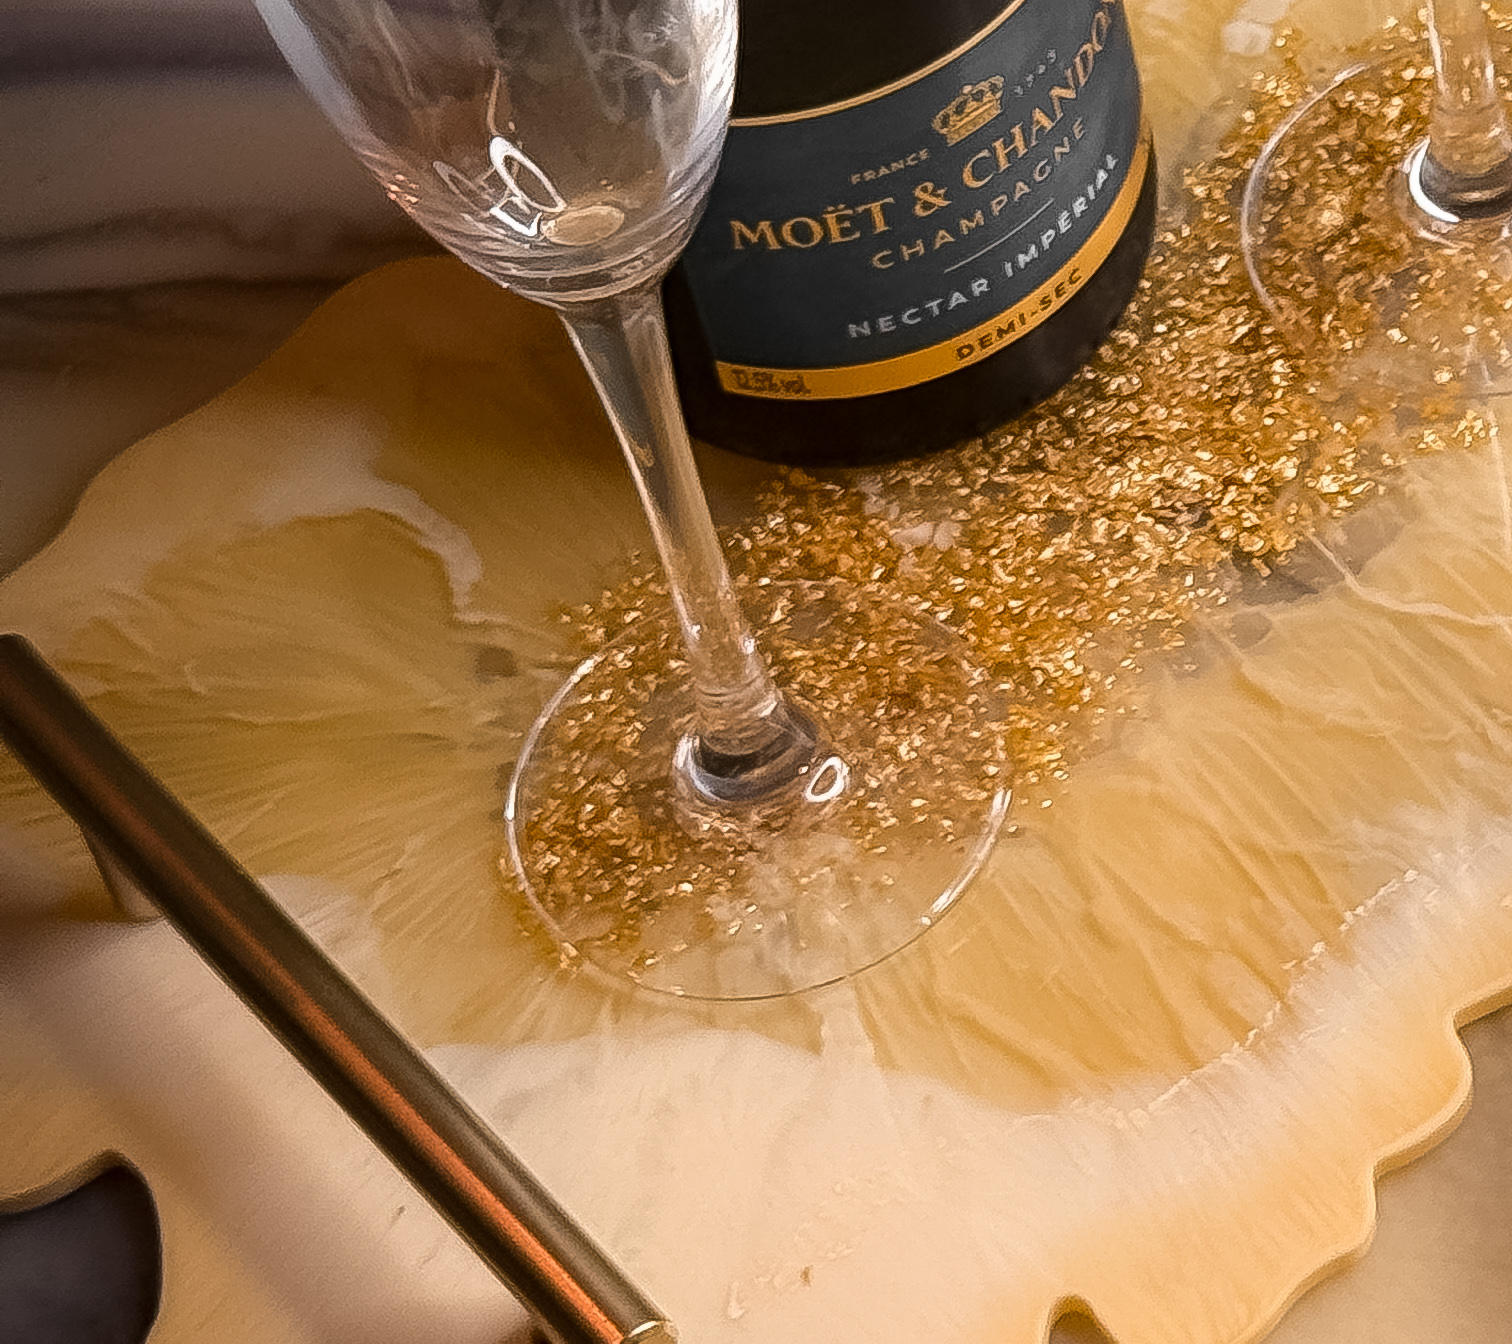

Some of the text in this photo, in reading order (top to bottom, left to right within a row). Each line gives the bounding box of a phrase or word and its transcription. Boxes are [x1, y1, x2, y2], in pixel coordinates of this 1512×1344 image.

[851, 148, 930, 185] FRANCE
[871, 117, 1087, 269] CHAMPAGNE
[730, 197, 895, 250] MOËT
[913, 182, 953, 217] &
[848, 278, 991, 338] NECTAR
[956, 267, 1082, 360] DEMI-SEC
